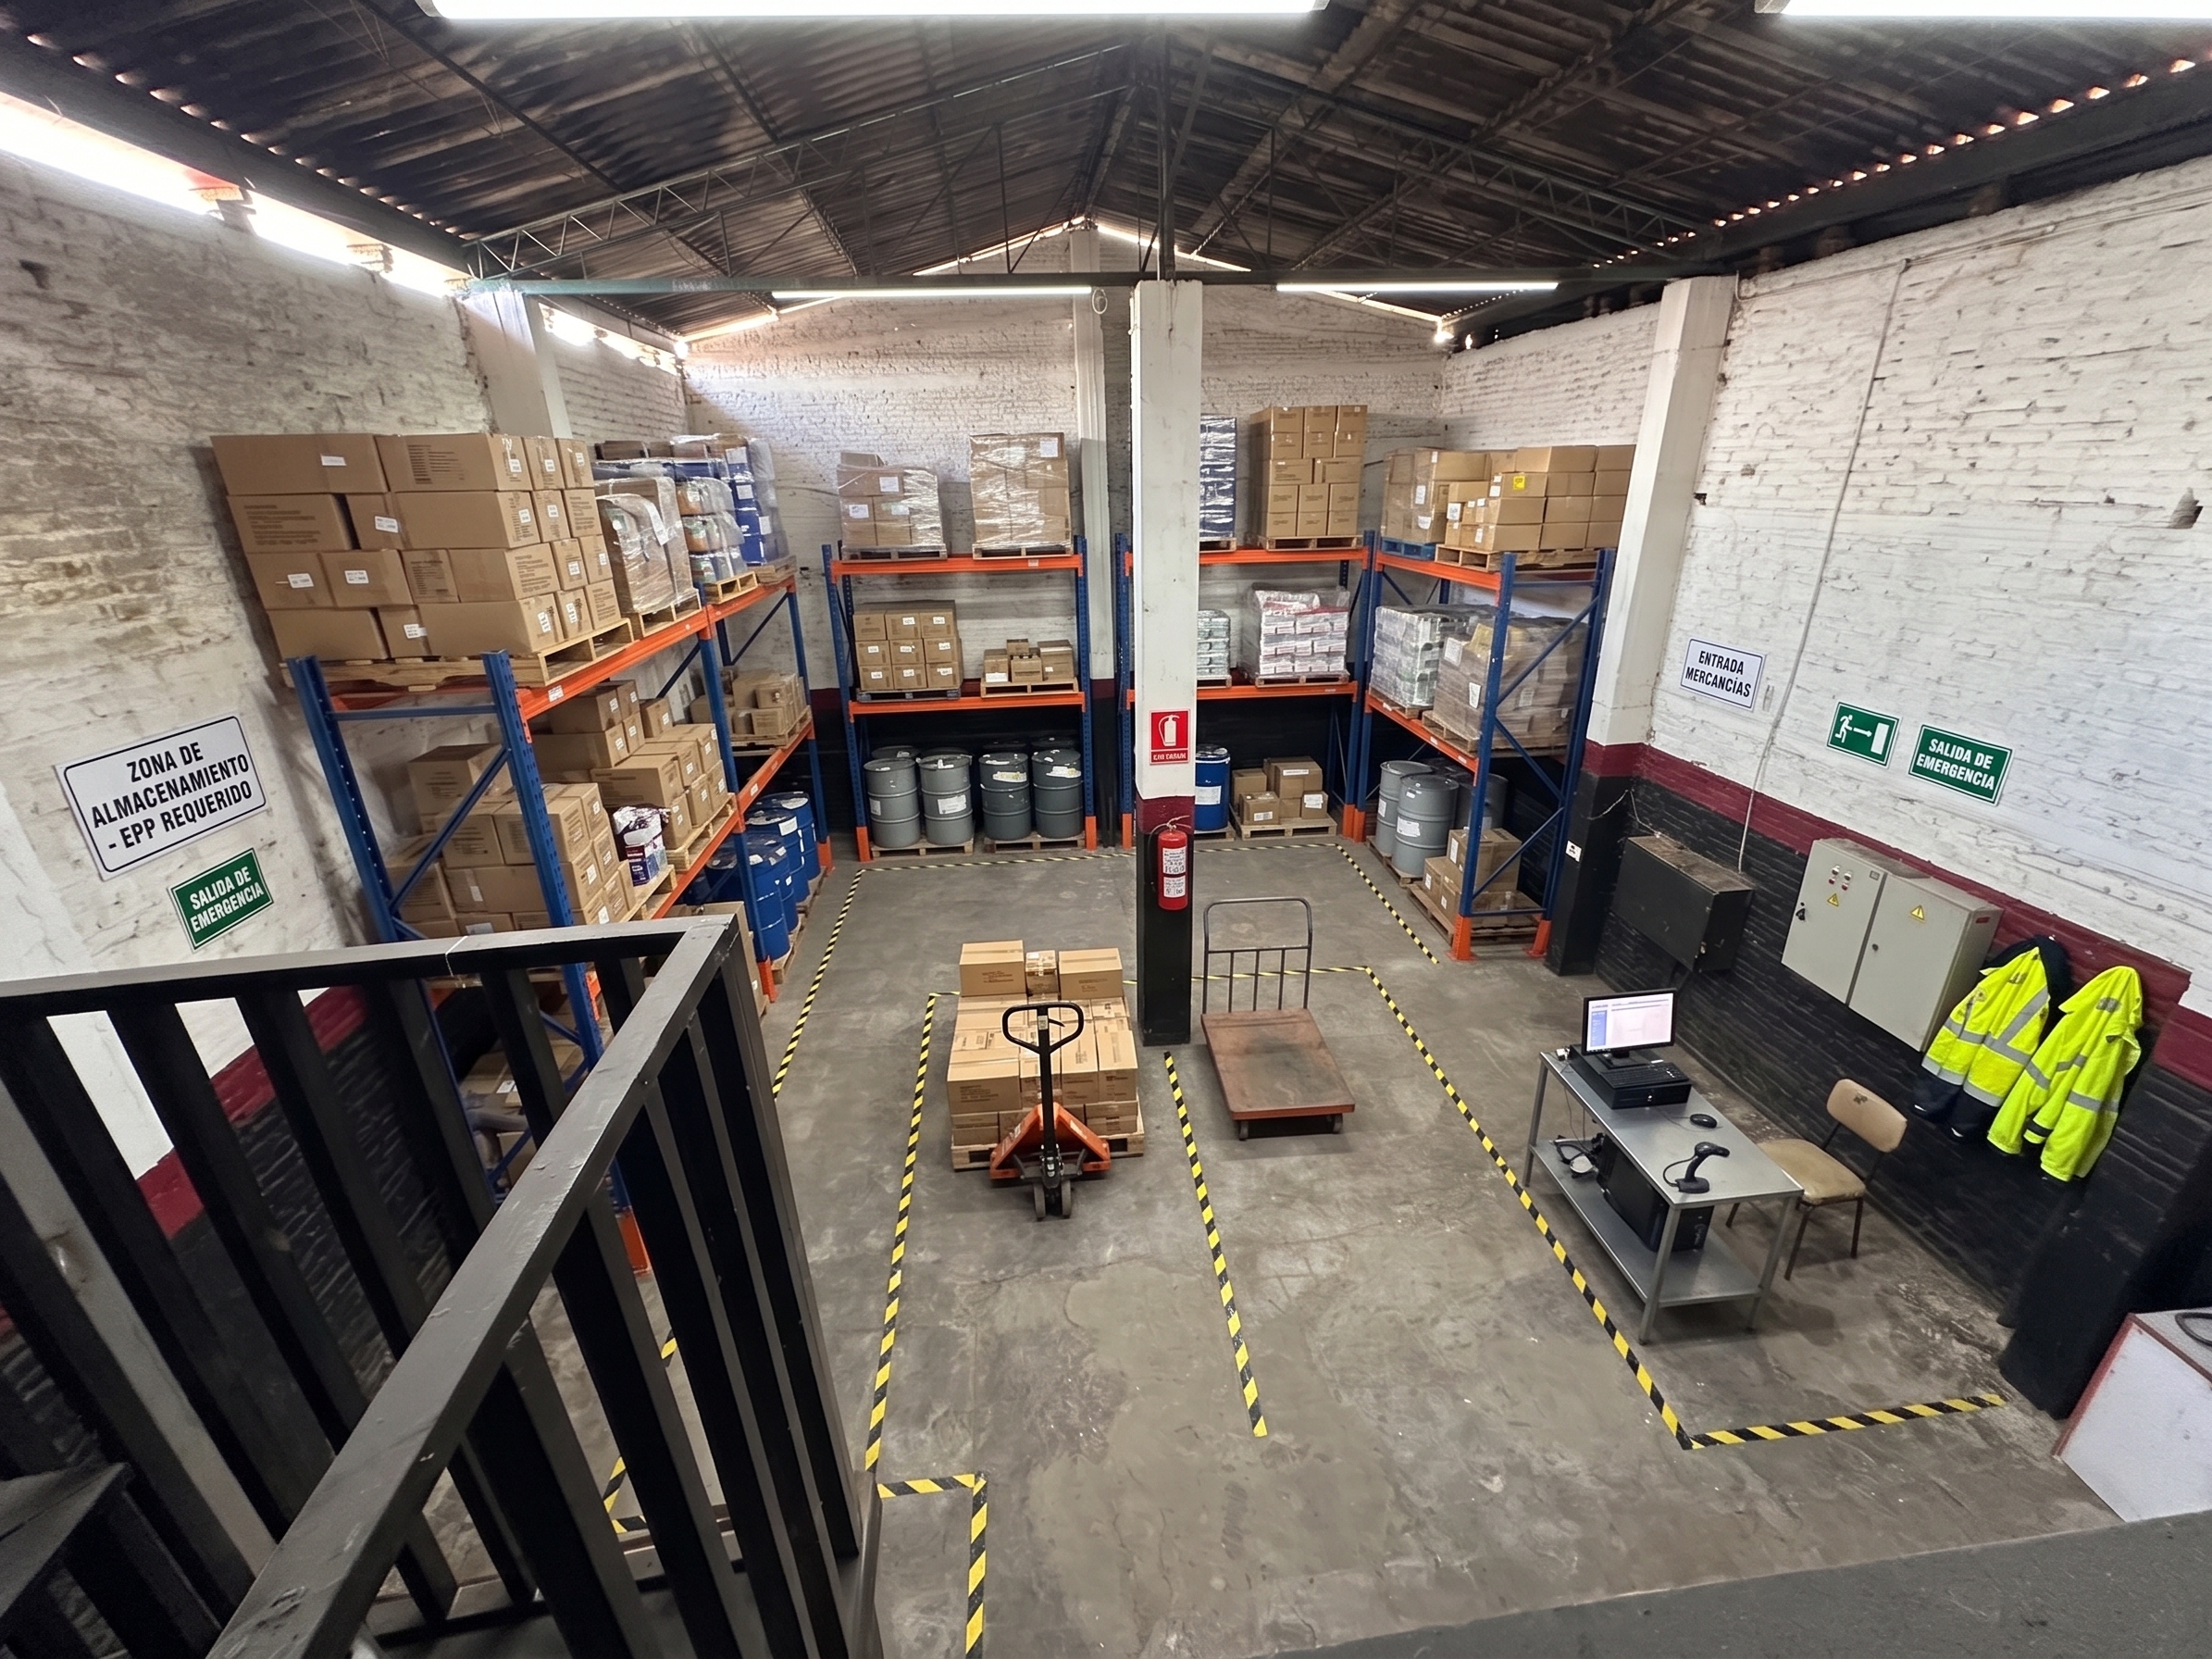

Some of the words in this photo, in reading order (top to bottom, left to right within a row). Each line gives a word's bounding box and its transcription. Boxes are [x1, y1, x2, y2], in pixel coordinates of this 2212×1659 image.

[1698, 651, 1744, 675] ENTRADA
[127, 752, 178, 782] ZONA
[180, 742, 204, 766] DE
[1916, 754, 1995, 790] EMERGENCIA
[1929, 738, 1971, 763] SALIDA
[1973, 752, 1994, 769] DE
[91, 754, 249, 828] ALMACENAMIENTO
[119, 818, 155, 848] EPP
[160, 780, 252, 832] REQUERIDO
[190, 876, 234, 910] SALIDA
[234, 867, 251, 887] DE
[190, 882, 264, 932] EMERGENCIA
